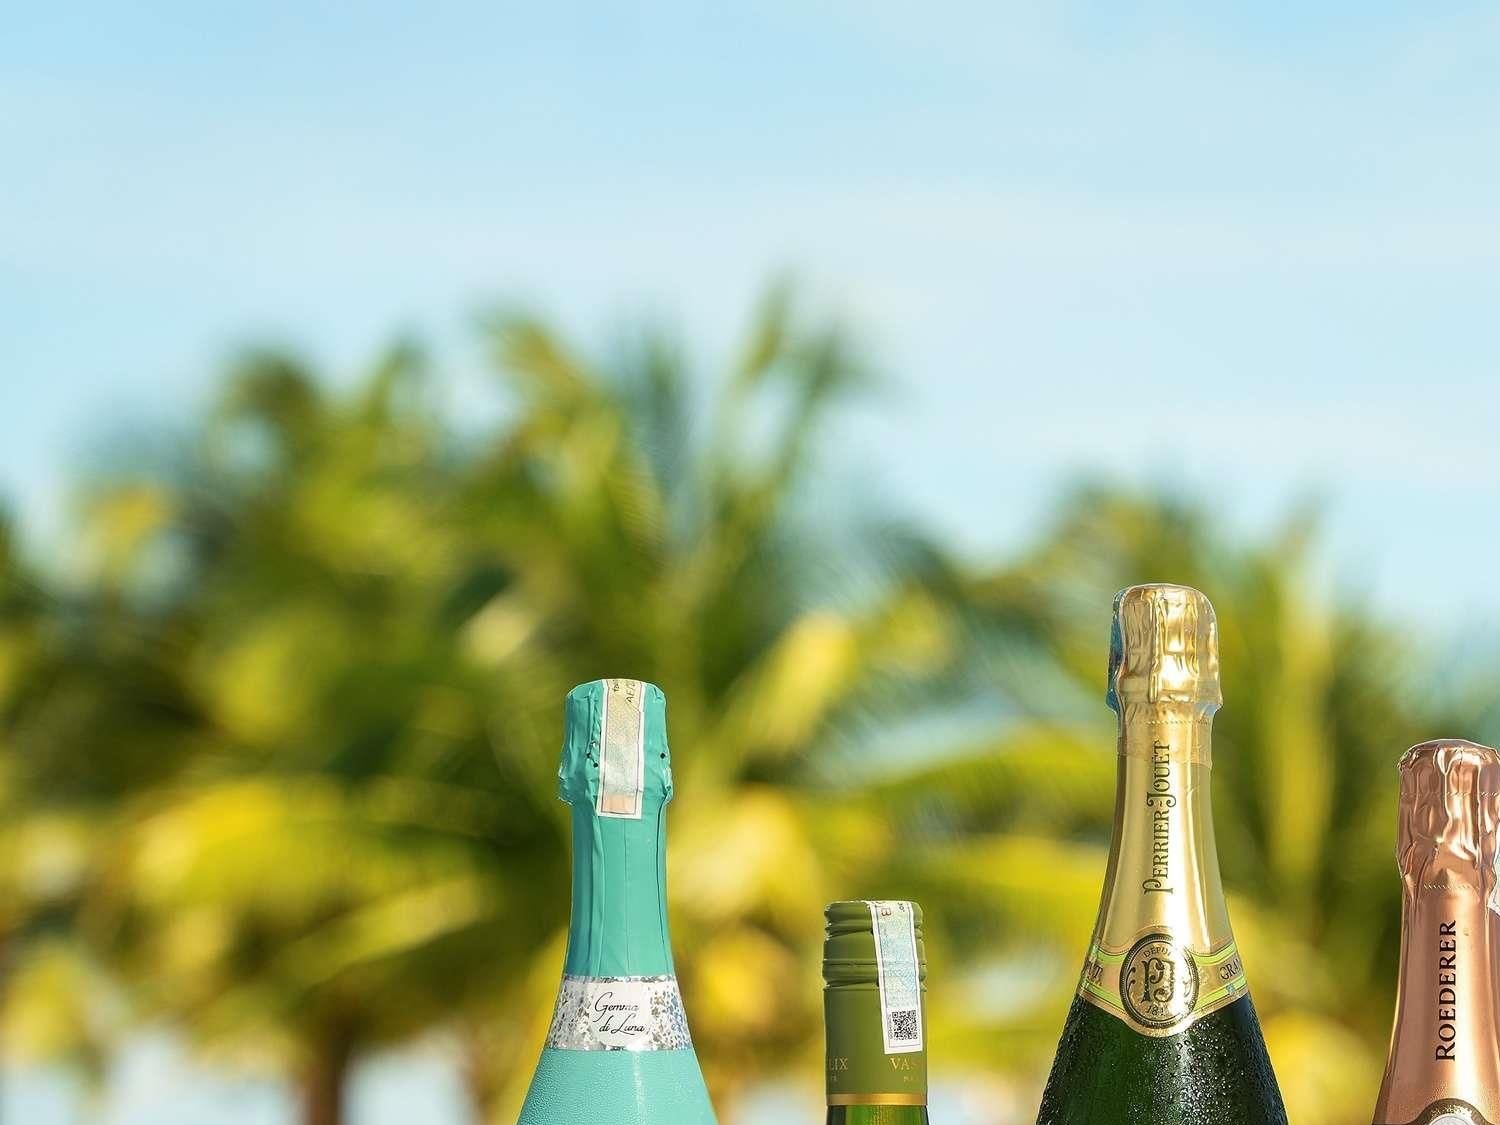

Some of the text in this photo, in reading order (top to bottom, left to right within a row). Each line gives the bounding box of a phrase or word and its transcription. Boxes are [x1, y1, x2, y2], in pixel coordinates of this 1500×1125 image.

[1436, 920, 1457, 1061] ROEDERER
[593, 991, 640, 1022] Gemma
[599, 1013, 646, 1036] di Luna
